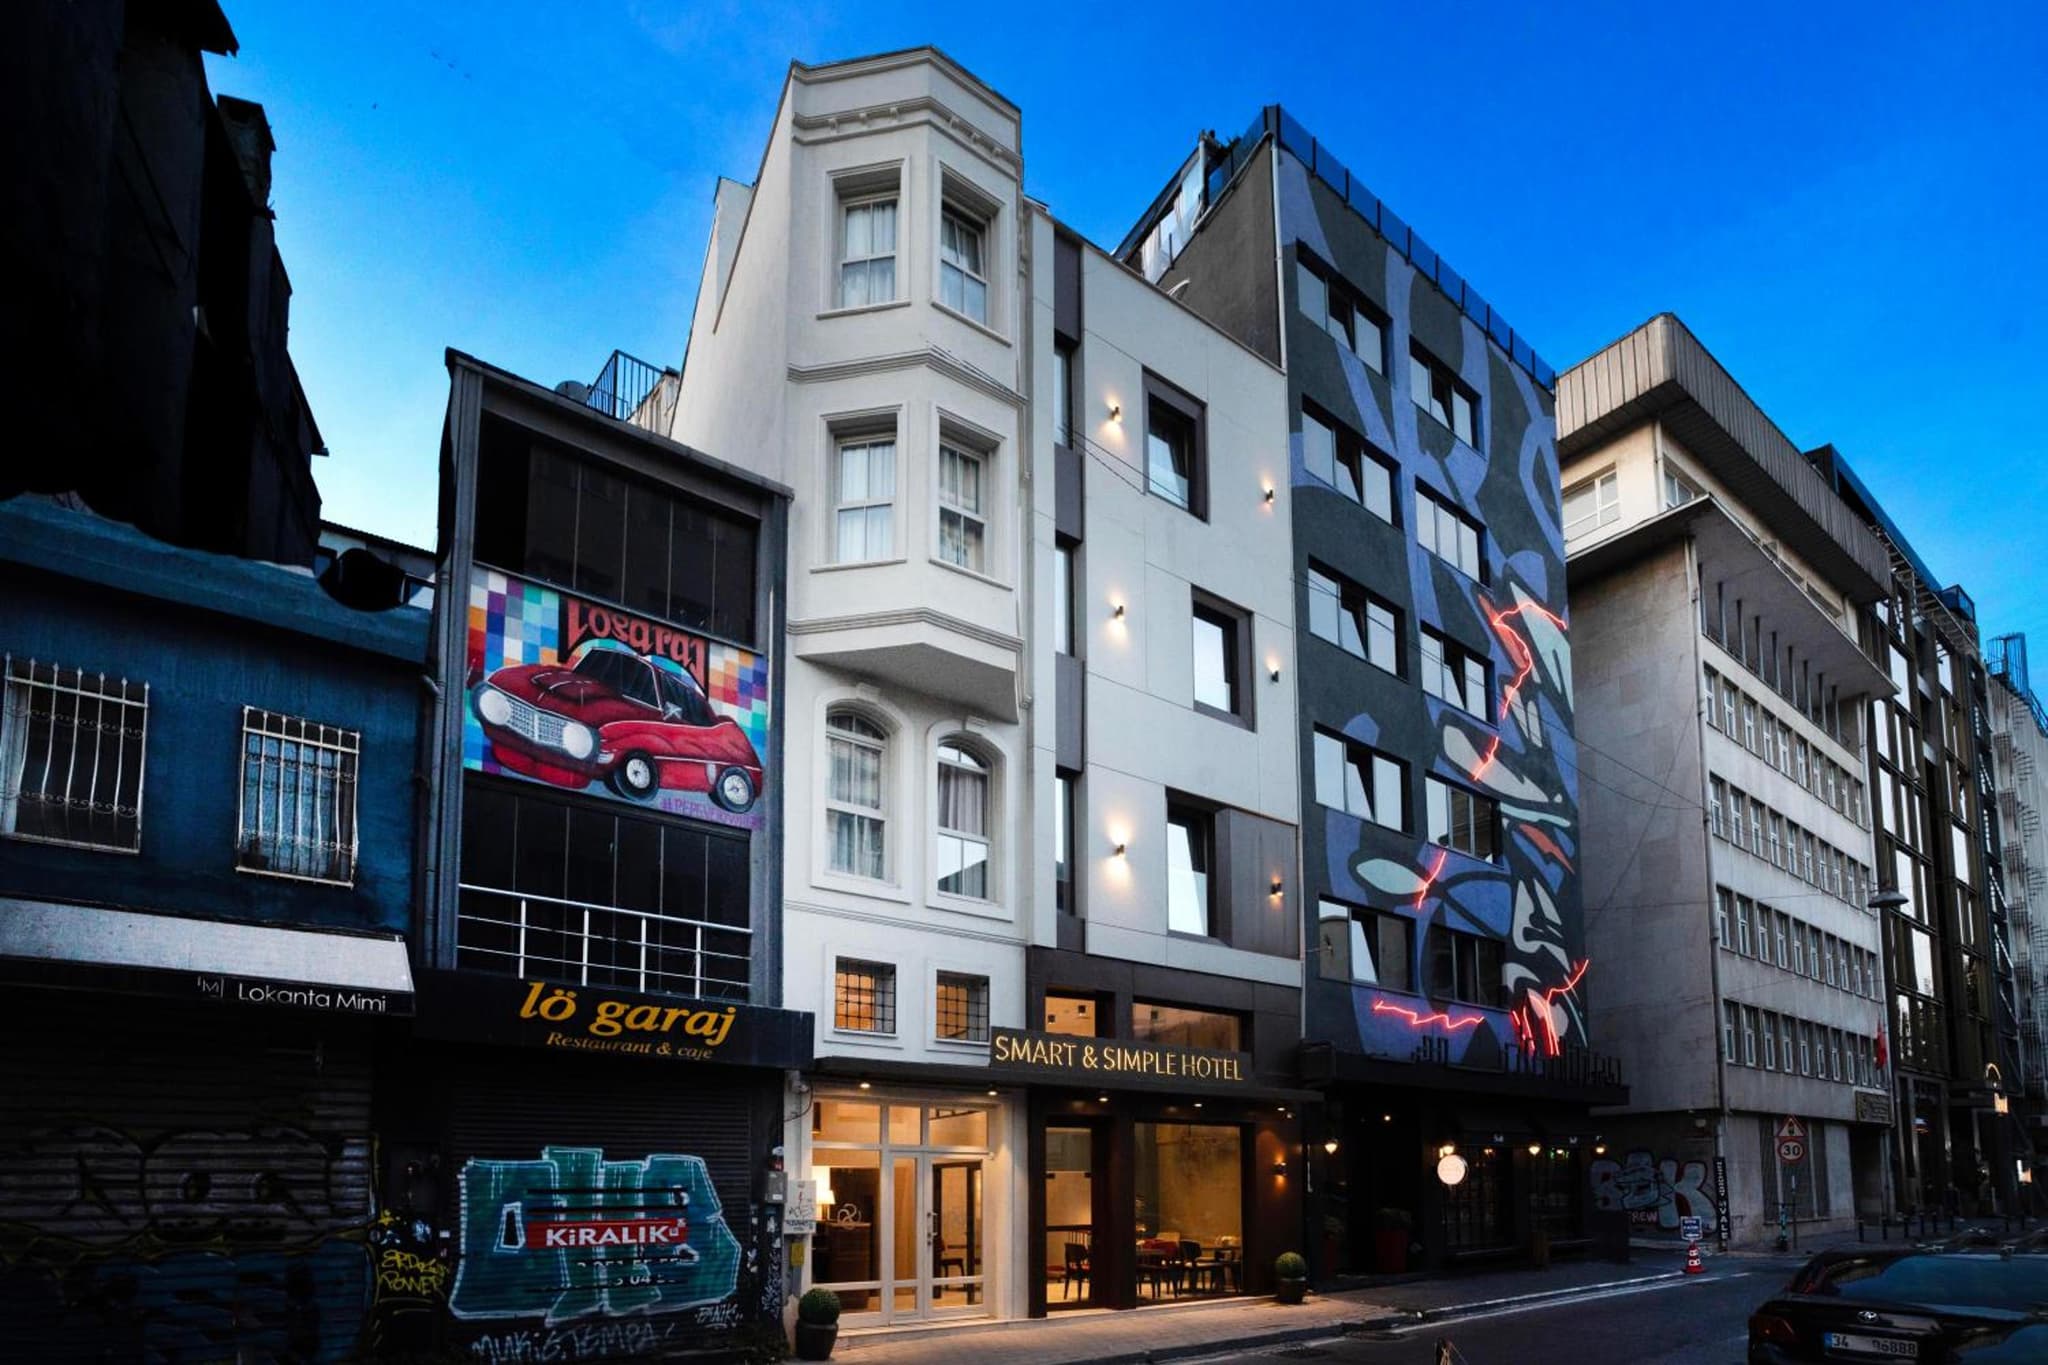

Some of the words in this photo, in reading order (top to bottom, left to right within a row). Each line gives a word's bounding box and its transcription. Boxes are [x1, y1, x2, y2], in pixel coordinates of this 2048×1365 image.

[238, 983, 330, 1008] Lokanta
[336, 991, 387, 1013] Mimi
[518, 980, 578, 1022] lö
[588, 1000, 738, 1047] garaj
[546, 1031, 653, 1056] Restaurant
[656, 1041, 672, 1057] &
[995, 1035, 1077, 1068] SMART
[1082, 1044, 1098, 1070] &
[1103, 1046, 1177, 1077] SIMPLE
[1182, 1053, 1244, 1081] HOTEL
[1783, 1145, 1801, 1156] 30
